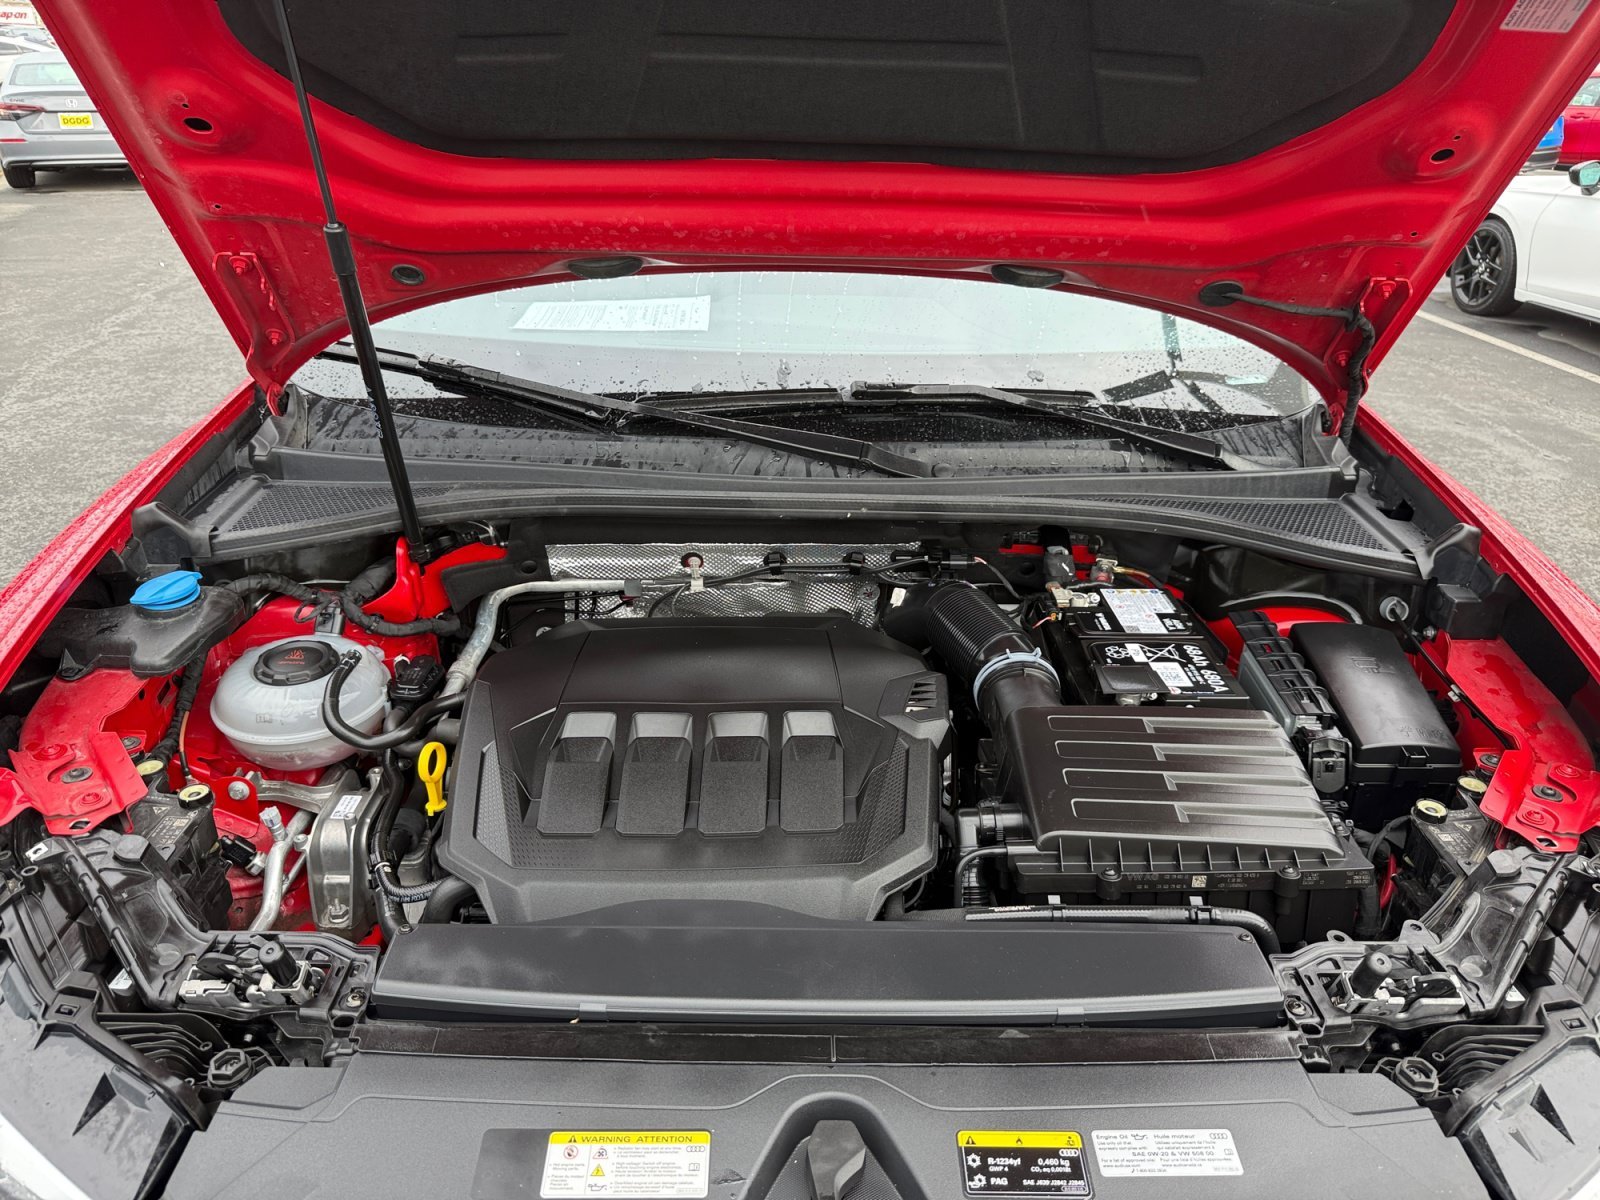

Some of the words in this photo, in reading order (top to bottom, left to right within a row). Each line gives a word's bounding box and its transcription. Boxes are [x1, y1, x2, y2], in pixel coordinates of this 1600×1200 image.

[62, 117, 89, 125] DGDG
[1183, 644, 1210, 667] 68Ah
[1199, 669, 1229, 693] 680A
[581, 1135, 631, 1143] WARNING
[636, 1135, 693, 1143] ATTENTION
[988, 1157, 1021, 1166] R-1234yf
[1060, 1158, 1070, 1167] kg
[990, 1177, 1008, 1186] PAG
